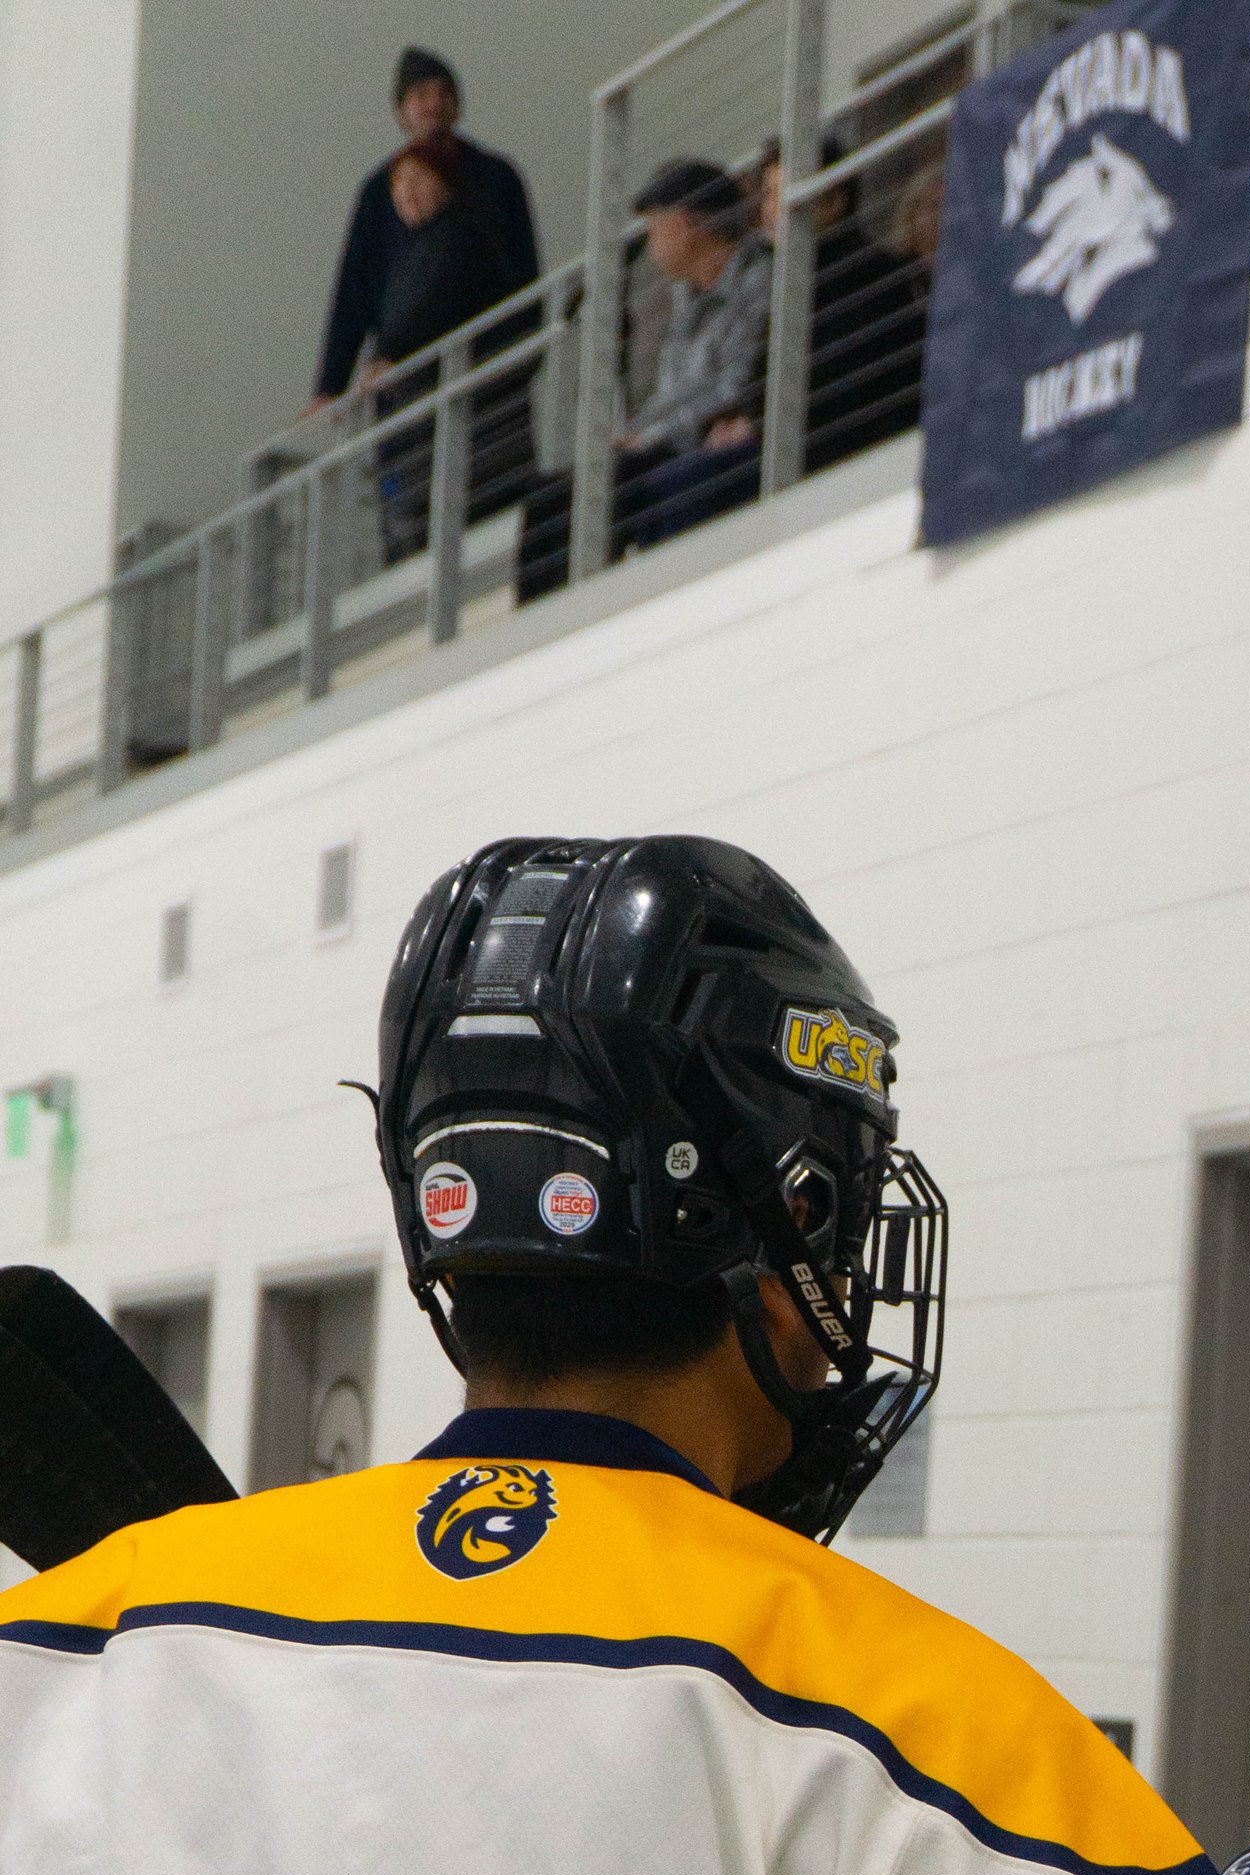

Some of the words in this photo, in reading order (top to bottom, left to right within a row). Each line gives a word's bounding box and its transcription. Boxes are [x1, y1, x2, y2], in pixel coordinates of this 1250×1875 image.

[672, 1147, 691, 1160] UK
[671, 1159, 690, 1170] CA
[425, 1183, 468, 1217] SHOW
[552, 1197, 591, 1213] HECC
[791, 1263, 853, 1351] BAUER
